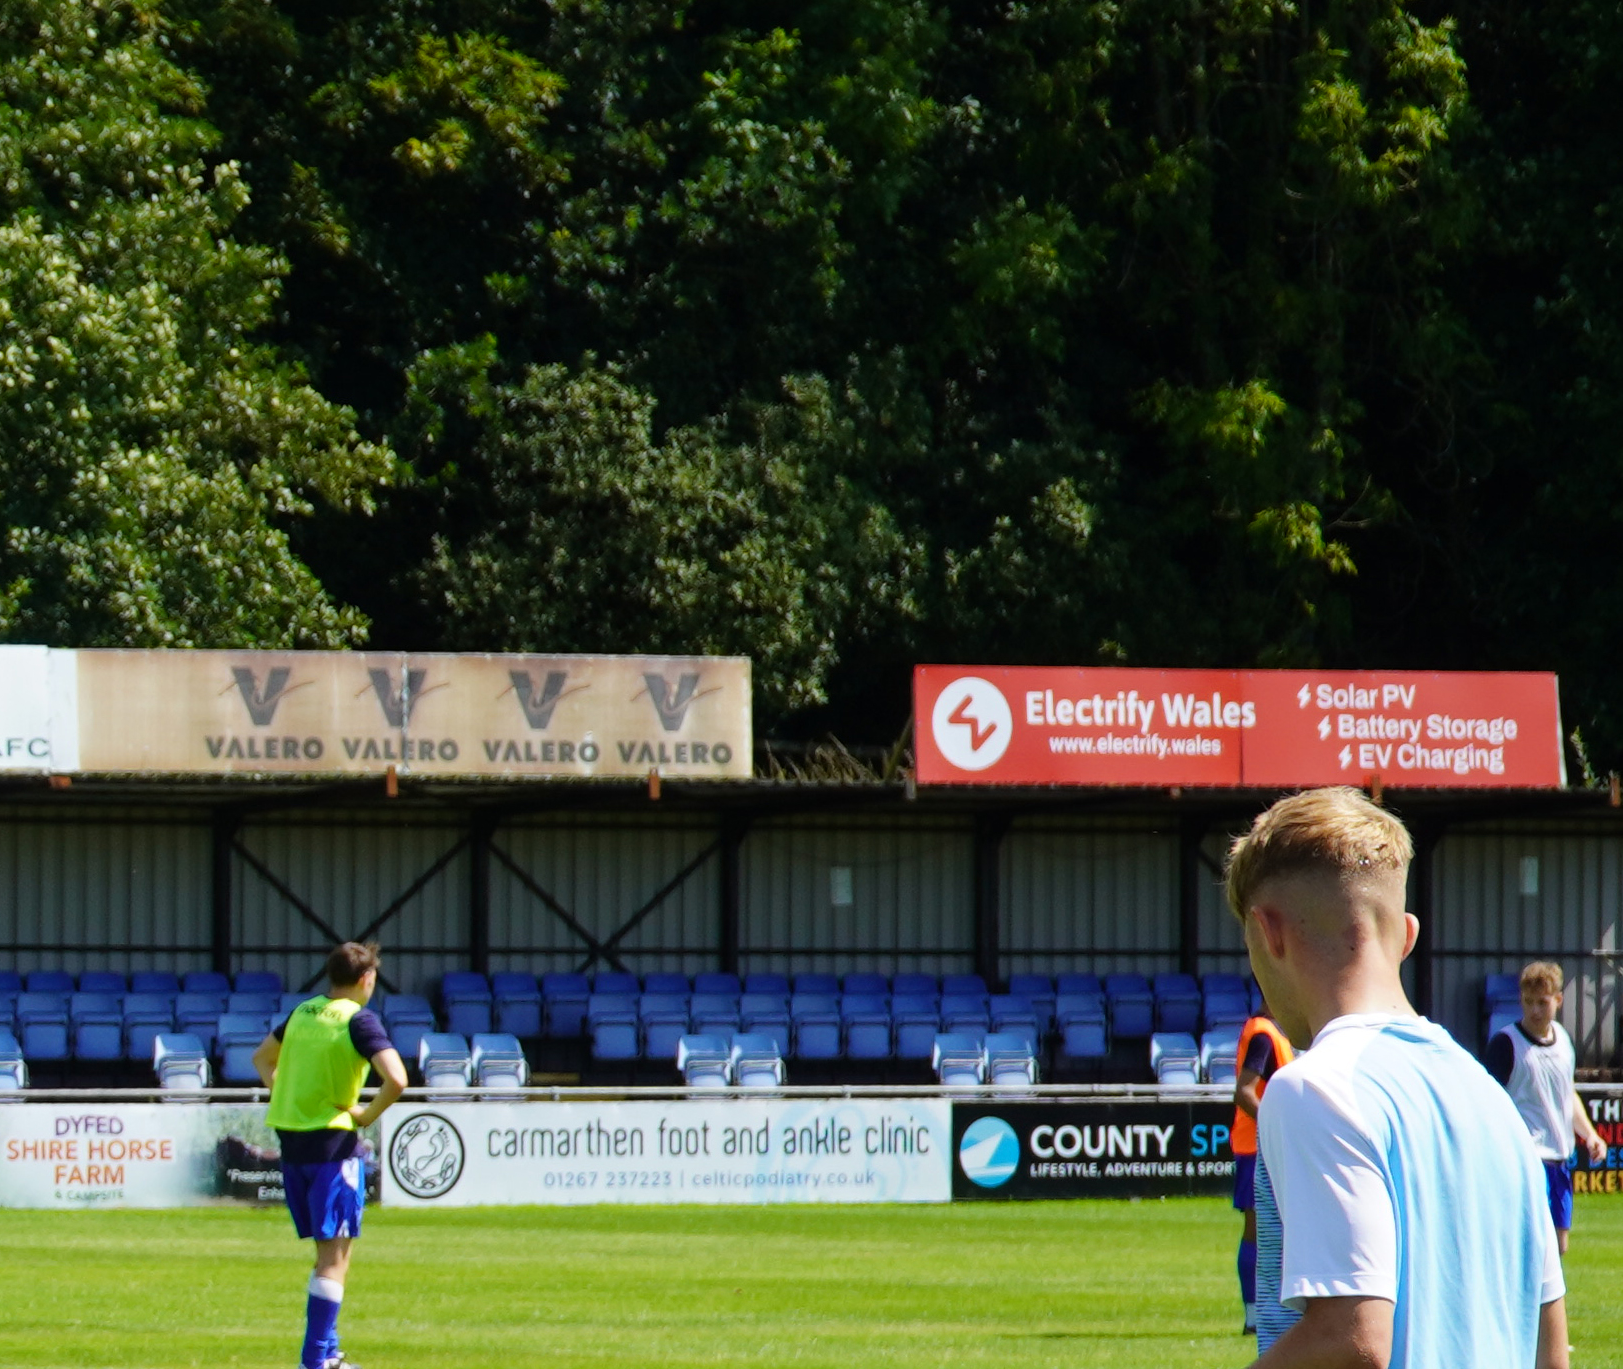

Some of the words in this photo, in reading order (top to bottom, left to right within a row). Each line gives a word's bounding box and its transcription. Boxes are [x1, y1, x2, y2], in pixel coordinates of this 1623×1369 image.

[1316, 683, 1378, 709] Solar
[1382, 685, 1415, 710] PV
[1026, 690, 1154, 731] Electrify
[1162, 691, 1256, 729] Wales
[1338, 714, 1422, 741] Battery
[1427, 716, 1517, 742] Storage
[205, 736, 324, 761] VALERO
[342, 737, 460, 762] VALERO
[483, 739, 600, 764] VALERO
[617, 741, 732, 766] VALERO
[1050, 733, 1222, 759] www.electrify.wales
[1359, 744, 1391, 769] EV
[1396, 744, 1505, 774] Charging
[55, 1115, 124, 1136] DYFED
[487, 1116, 644, 1157] carmarthen
[659, 1117, 710, 1156] foot
[722, 1116, 769, 1155] and
[783, 1116, 851, 1155] ankle
[865, 1115, 930, 1155] clinic
[7, 1139, 78, 1160] SHIRE
[88, 1139, 173, 1160] HORSE
[1030, 1124, 1175, 1158] COUNTY
[55, 1165, 125, 1185] FARM
[544, 1171, 598, 1188] 01267
[606, 1171, 672, 1188] 237223
[692, 1170, 875, 1189] celticpodiatry.co.uk
[1030, 1162, 1102, 1178] LIFESTYLE,
[1105, 1161, 1183, 1176] ADVENTURE
